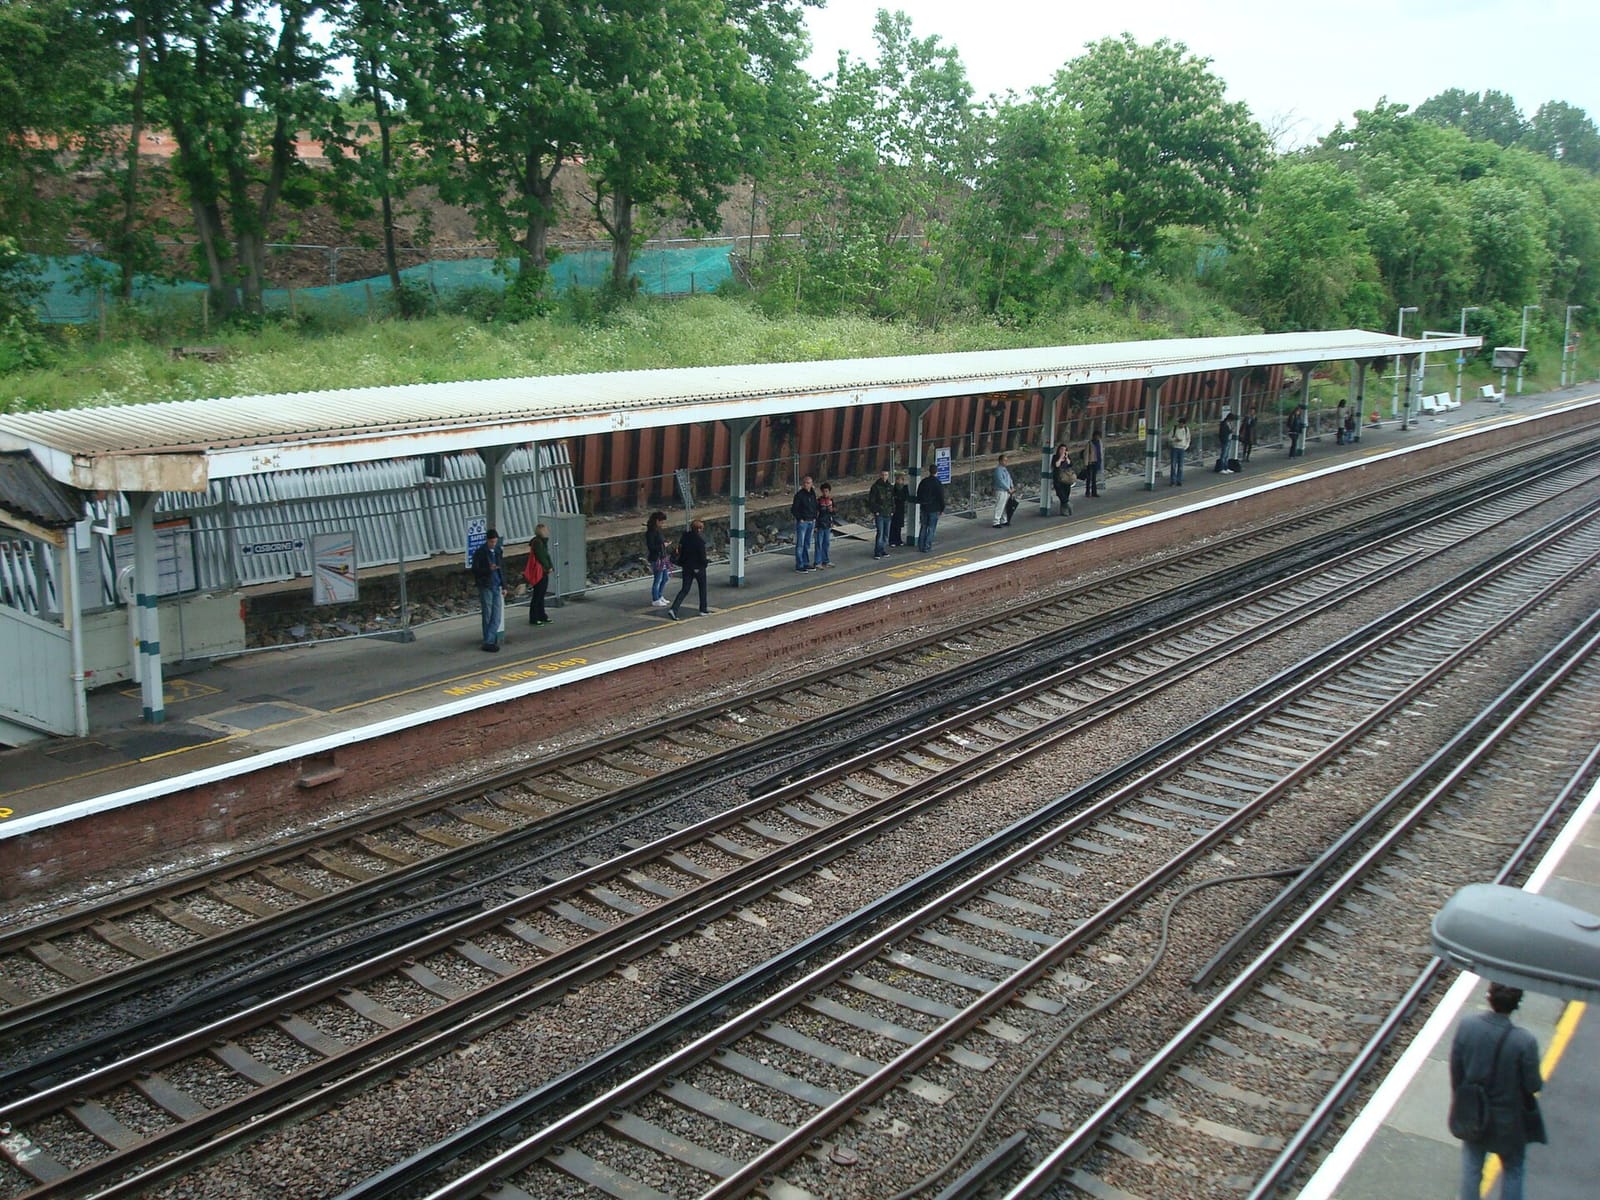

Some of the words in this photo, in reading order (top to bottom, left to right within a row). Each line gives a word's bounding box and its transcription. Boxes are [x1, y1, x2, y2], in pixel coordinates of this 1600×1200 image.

[443, 679, 501, 695] Mind
[500, 670, 538, 682] the
[538, 657, 587, 671] Step
